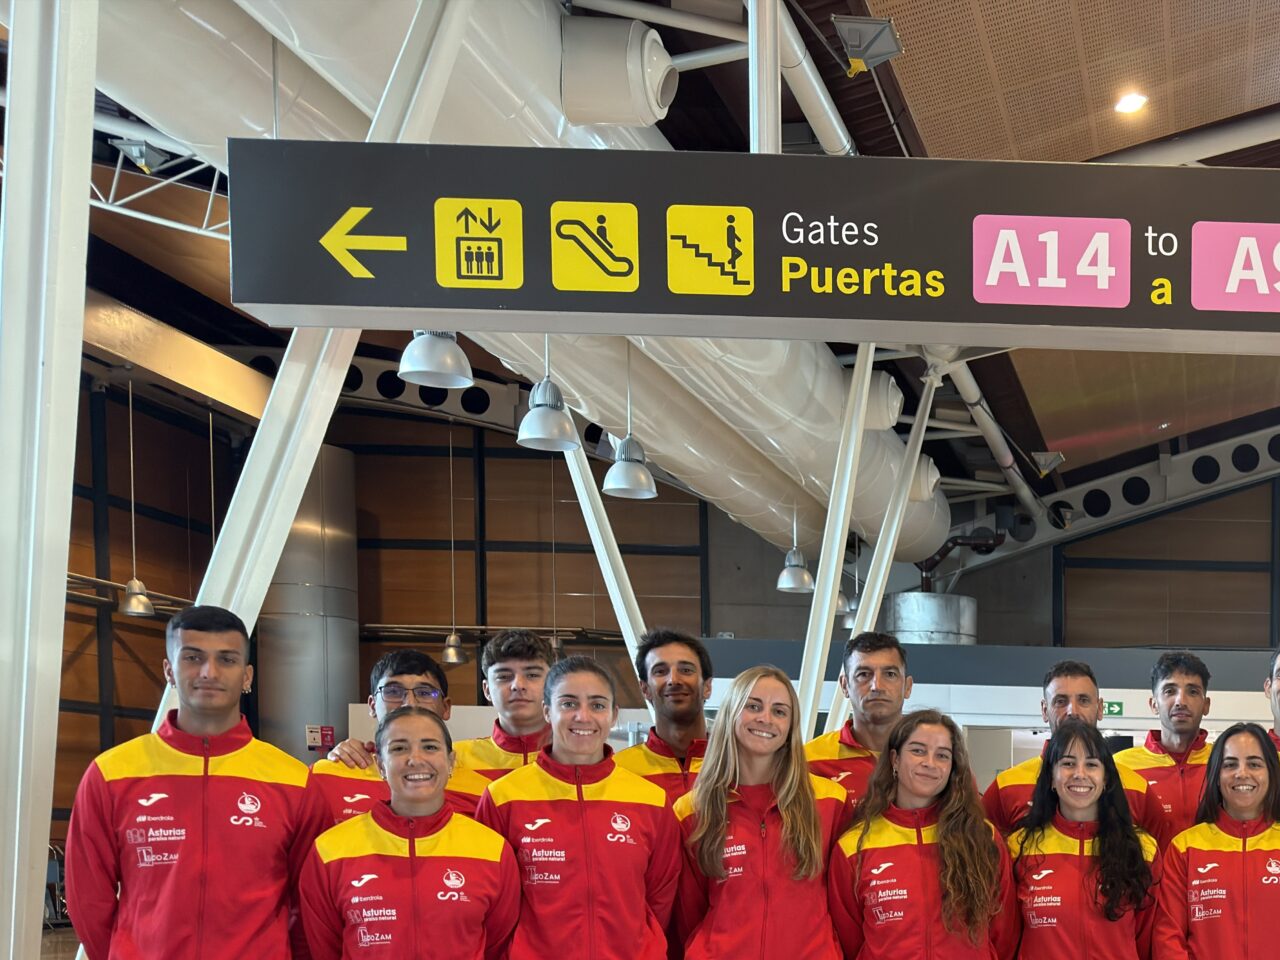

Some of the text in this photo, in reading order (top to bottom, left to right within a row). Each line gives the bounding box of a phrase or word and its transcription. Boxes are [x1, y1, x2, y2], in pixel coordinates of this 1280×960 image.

[782, 212, 879, 246] Gates
[1145, 226, 1178, 256] to
[985, 229, 1116, 290] A14
[781, 256, 945, 297] Puertas
[1150, 277, 1173, 305] a
[148, 828, 186, 837] Asturias
[532, 848, 565, 857] Asturias
[724, 845, 745, 853] turias
[878, 889, 907, 898] Asturias
[363, 908, 396, 917] Asturias
